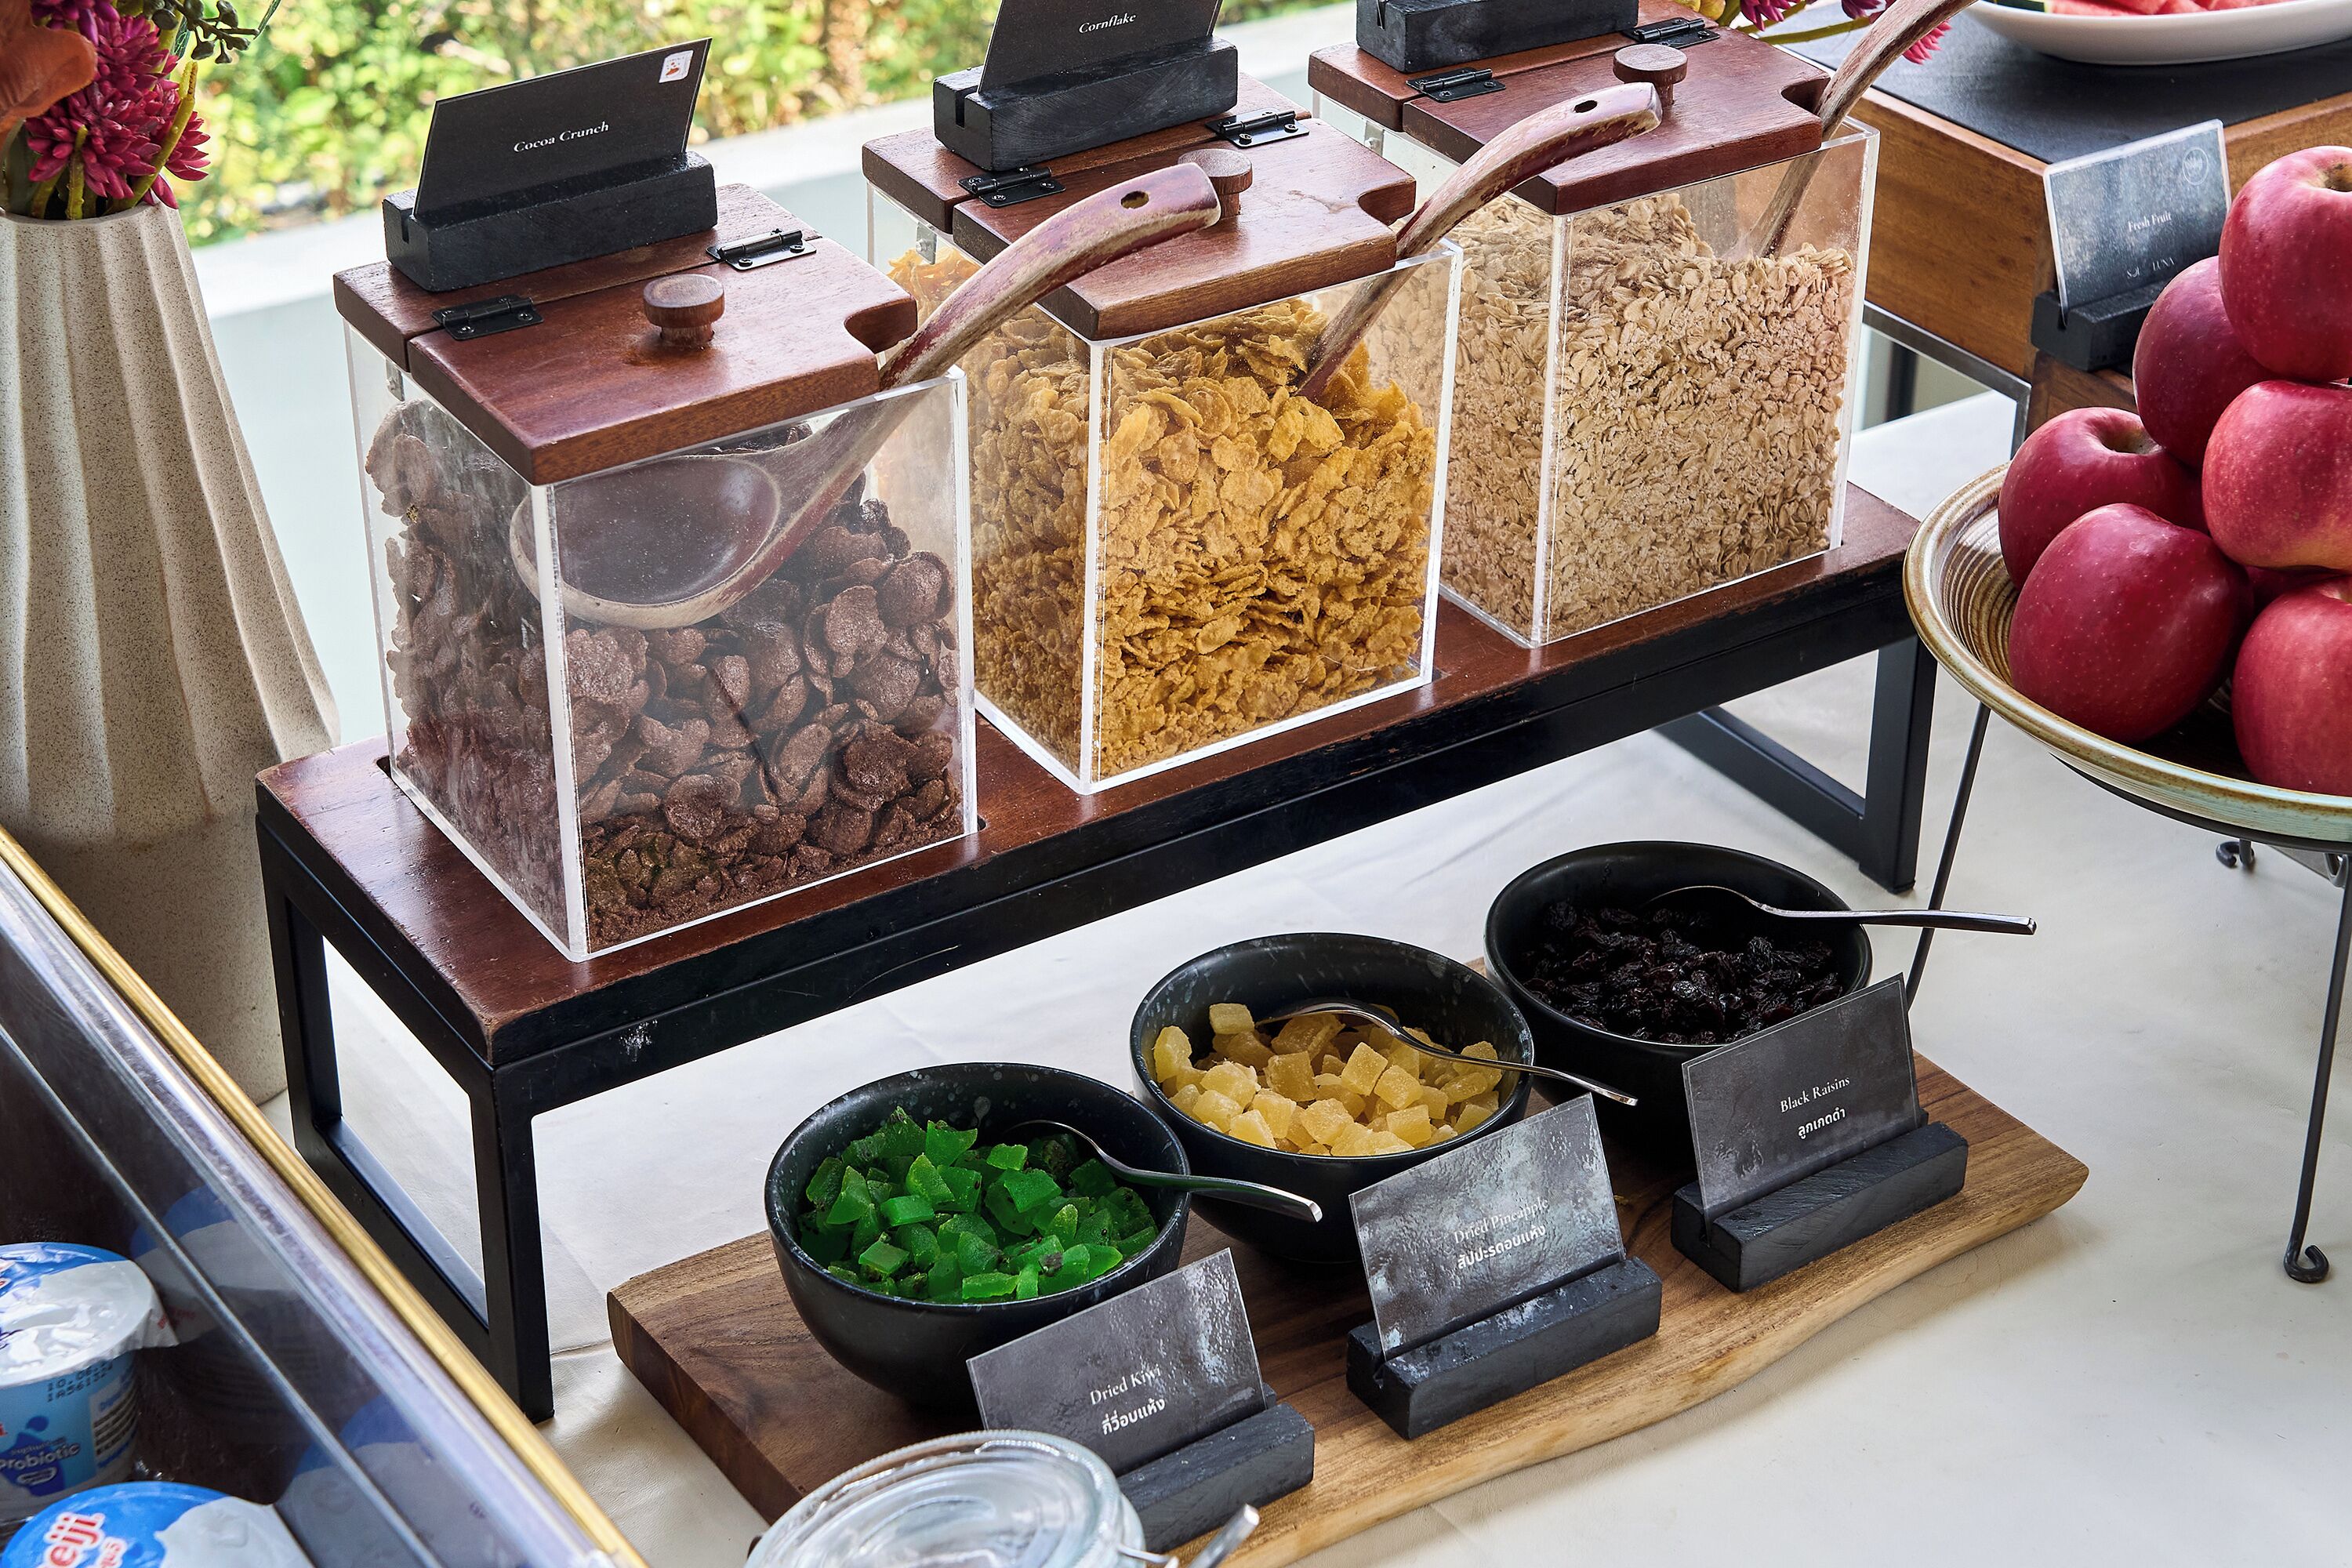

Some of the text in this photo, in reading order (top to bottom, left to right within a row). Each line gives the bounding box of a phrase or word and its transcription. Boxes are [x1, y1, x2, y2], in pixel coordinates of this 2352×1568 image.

[1078, 12, 1136, 34] Cornflake
[513, 120, 610, 154] Cocoa Crunch
[2128, 211, 2172, 233] Fresh Fruit
[1780, 1076, 1850, 1112] Black Raisins
[1798, 1106, 1846, 1140] ลูกเกดดำ
[1454, 1196, 1550, 1244] Dried Pineapple
[1089, 1363, 1161, 1406] Dried Kiwi
[42, 1516, 99, 1568] eiji
